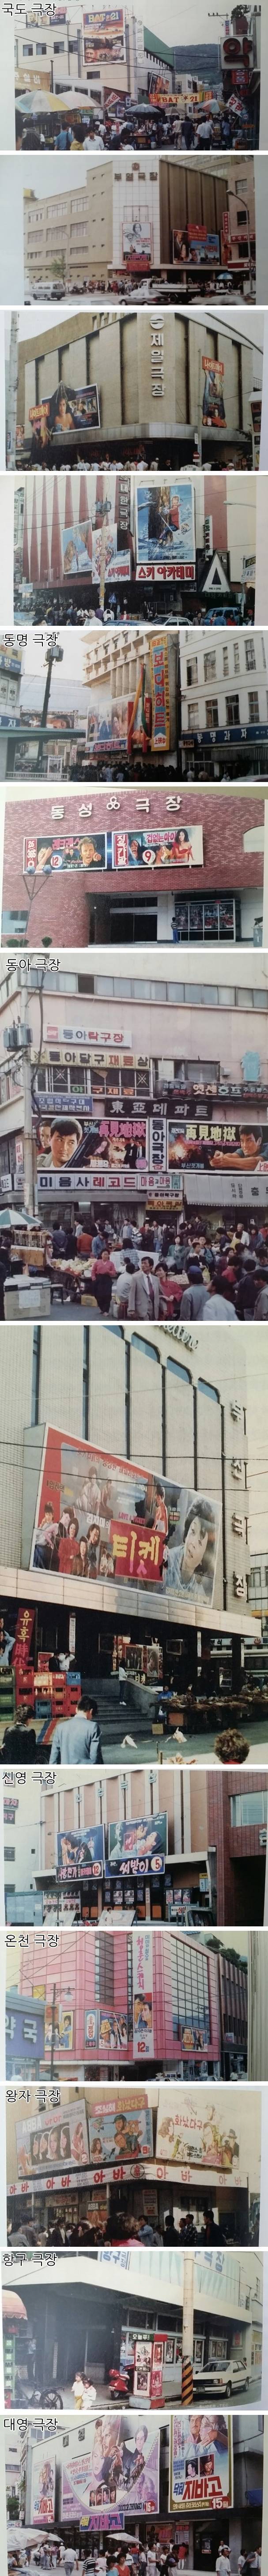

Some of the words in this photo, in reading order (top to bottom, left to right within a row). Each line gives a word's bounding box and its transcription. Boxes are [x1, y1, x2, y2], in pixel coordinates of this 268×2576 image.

[89, 14, 106, 23] BAT
[223, 38, 253, 66] 약
[151, 333, 165, 397] 제일극장
[119, 483, 129, 530] 대한극장
[138, 567, 155, 579] 스키
[157, 565, 194, 579] 아카데미
[197, 729, 247, 743] 동명과자
[51, 803, 92, 820] 동성
[136, 796, 182, 813] 극장
[52, 857, 59, 866] 12
[145, 851, 152, 861] 9
[63, 1029, 124, 1043] 동아탁구장
[49, 1051, 148, 1066] 동아당구재료상
[110, 1101, 208, 1117] 東亞데파트
[185, 1124, 236, 1141] 再見地獄
[152, 1120, 165, 1165] 동아극장
[141, 1176, 170, 1187] 마음과마음
[112, 1531, 161, 1575] 티켓
[93, 1865, 99, 1875] 12
[119, 1858, 149, 1874] 씨받이
[155, 1859, 160, 1869] 5
[137, 2042, 145, 2053] 12
[94, 2104, 116, 2115] 조심해
[22, 2117, 42, 2133] ABBA
[182, 2476, 223, 2500] 지바고
[38, 2497, 53, 2514] 지바고
[211, 2498, 223, 2509] 15
[89, 2513, 122, 2530] 지바고
